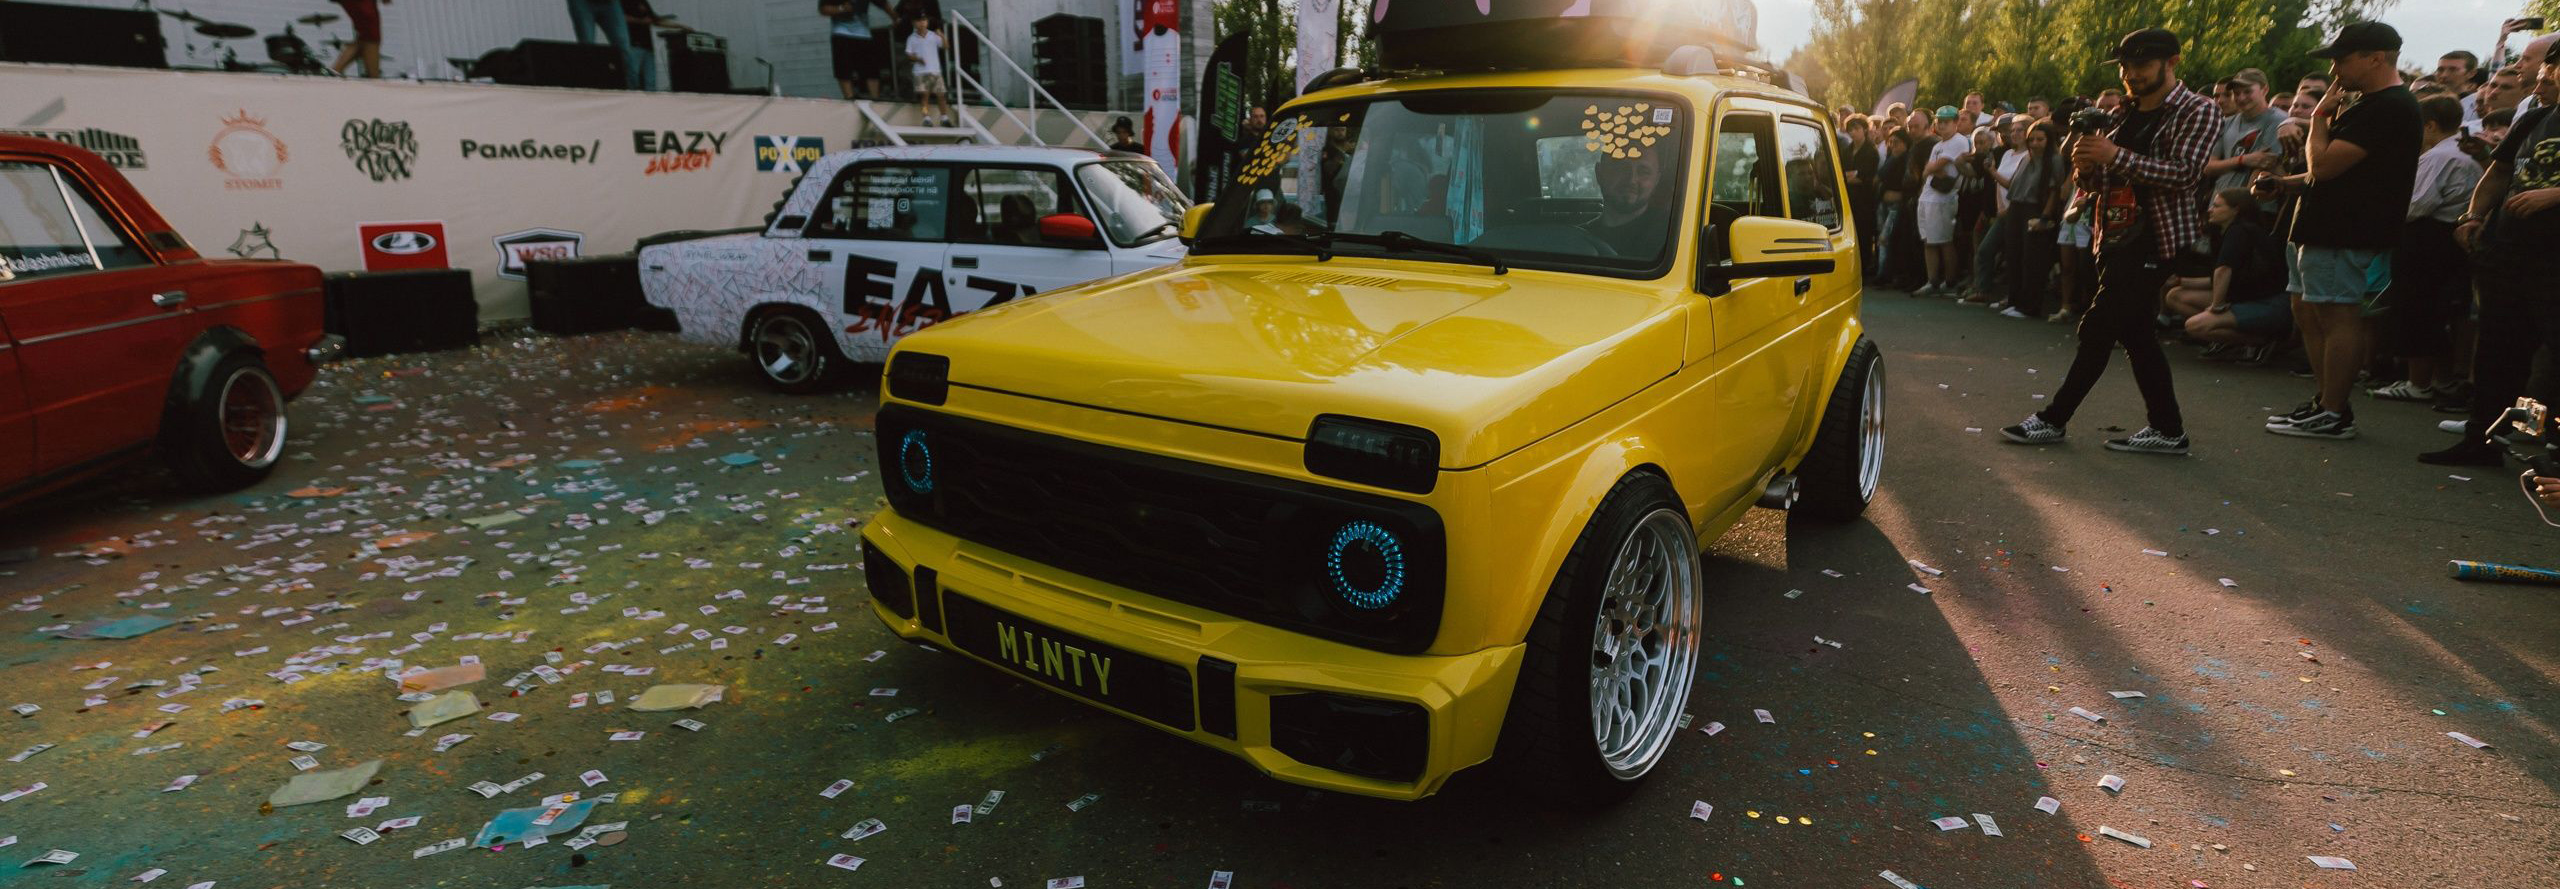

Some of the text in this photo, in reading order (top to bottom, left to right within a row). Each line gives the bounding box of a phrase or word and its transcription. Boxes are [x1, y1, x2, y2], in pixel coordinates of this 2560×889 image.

[632, 129, 728, 155] EAZY
[644, 149, 716, 175] ENERGY
[843, 253, 1037, 326] EAZ
[995, 620, 1112, 696] MINTY
